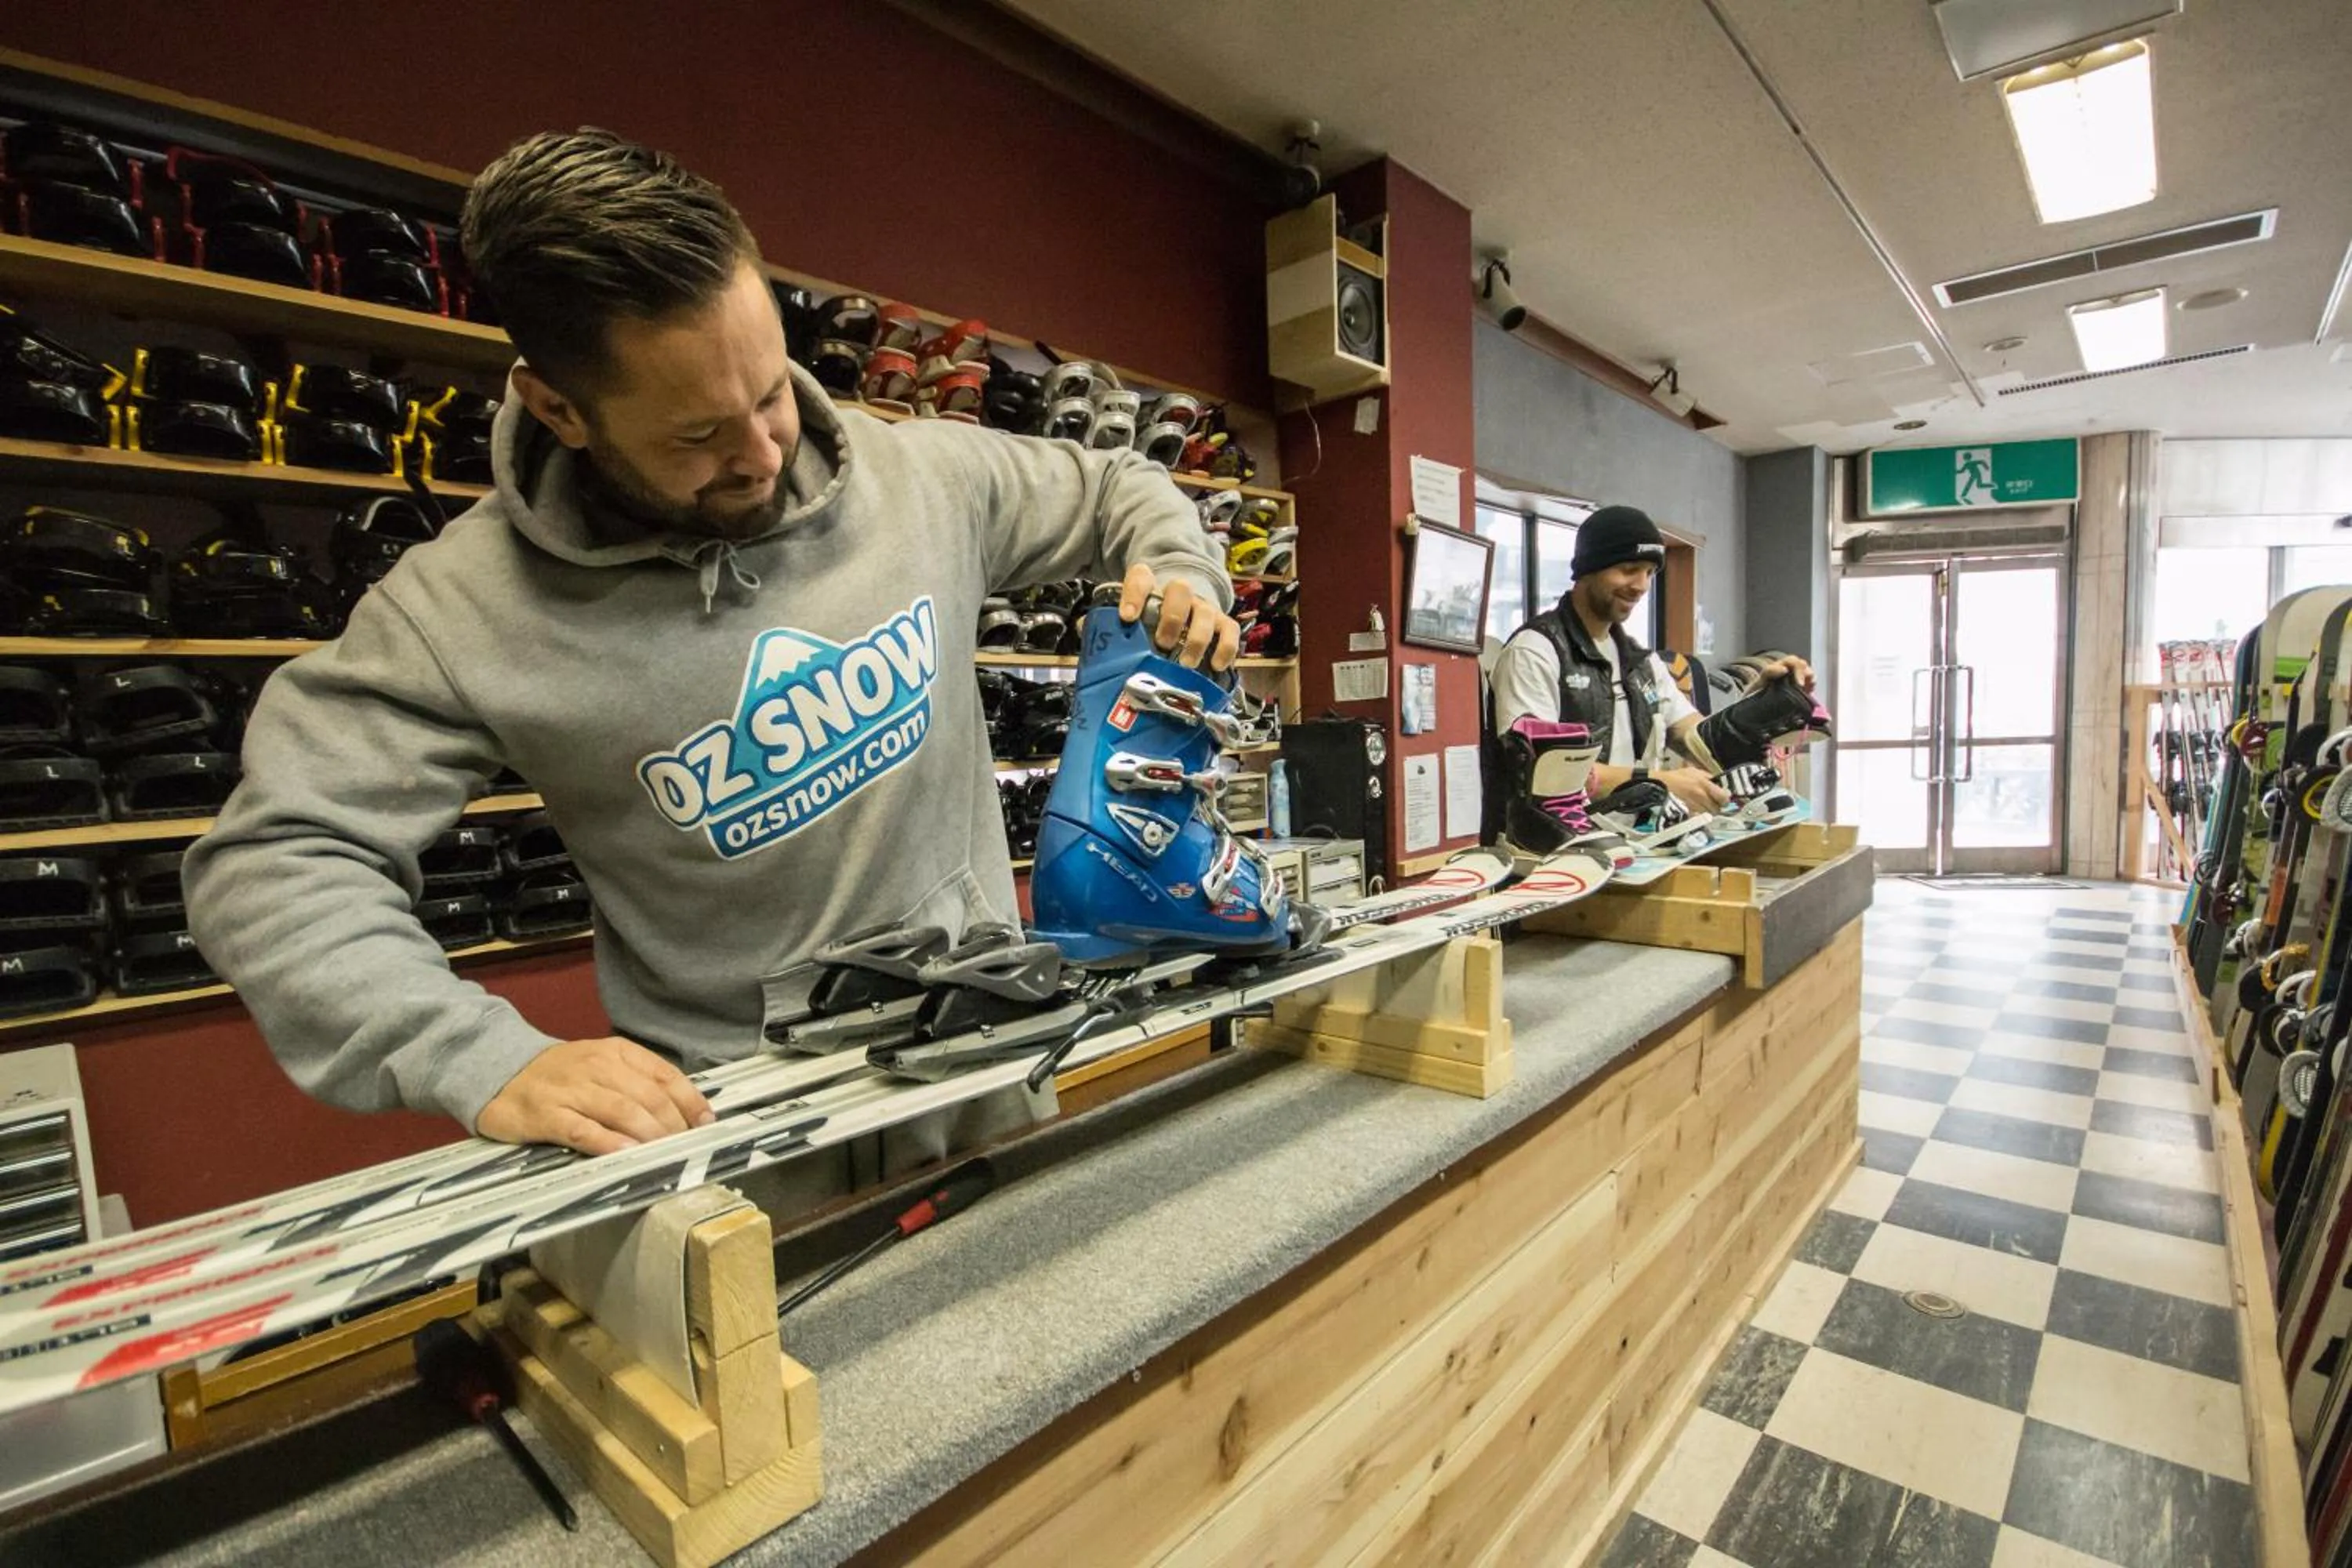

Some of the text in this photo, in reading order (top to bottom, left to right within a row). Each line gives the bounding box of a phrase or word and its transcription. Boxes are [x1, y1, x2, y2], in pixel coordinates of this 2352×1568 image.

[115, 677, 132, 688] L
[648, 604, 936, 824] OZ SNOW
[194, 756, 207, 768] L
[46, 764, 60, 779] L
[725, 708, 927, 848] ozsnow.com
[459, 831, 475, 844] M
[37, 861, 59, 877] M
[1085, 840, 1160, 903] HEAD
[557, 888, 569, 899] M
[447, 902, 461, 913] M
[1, 956, 25, 973] M
